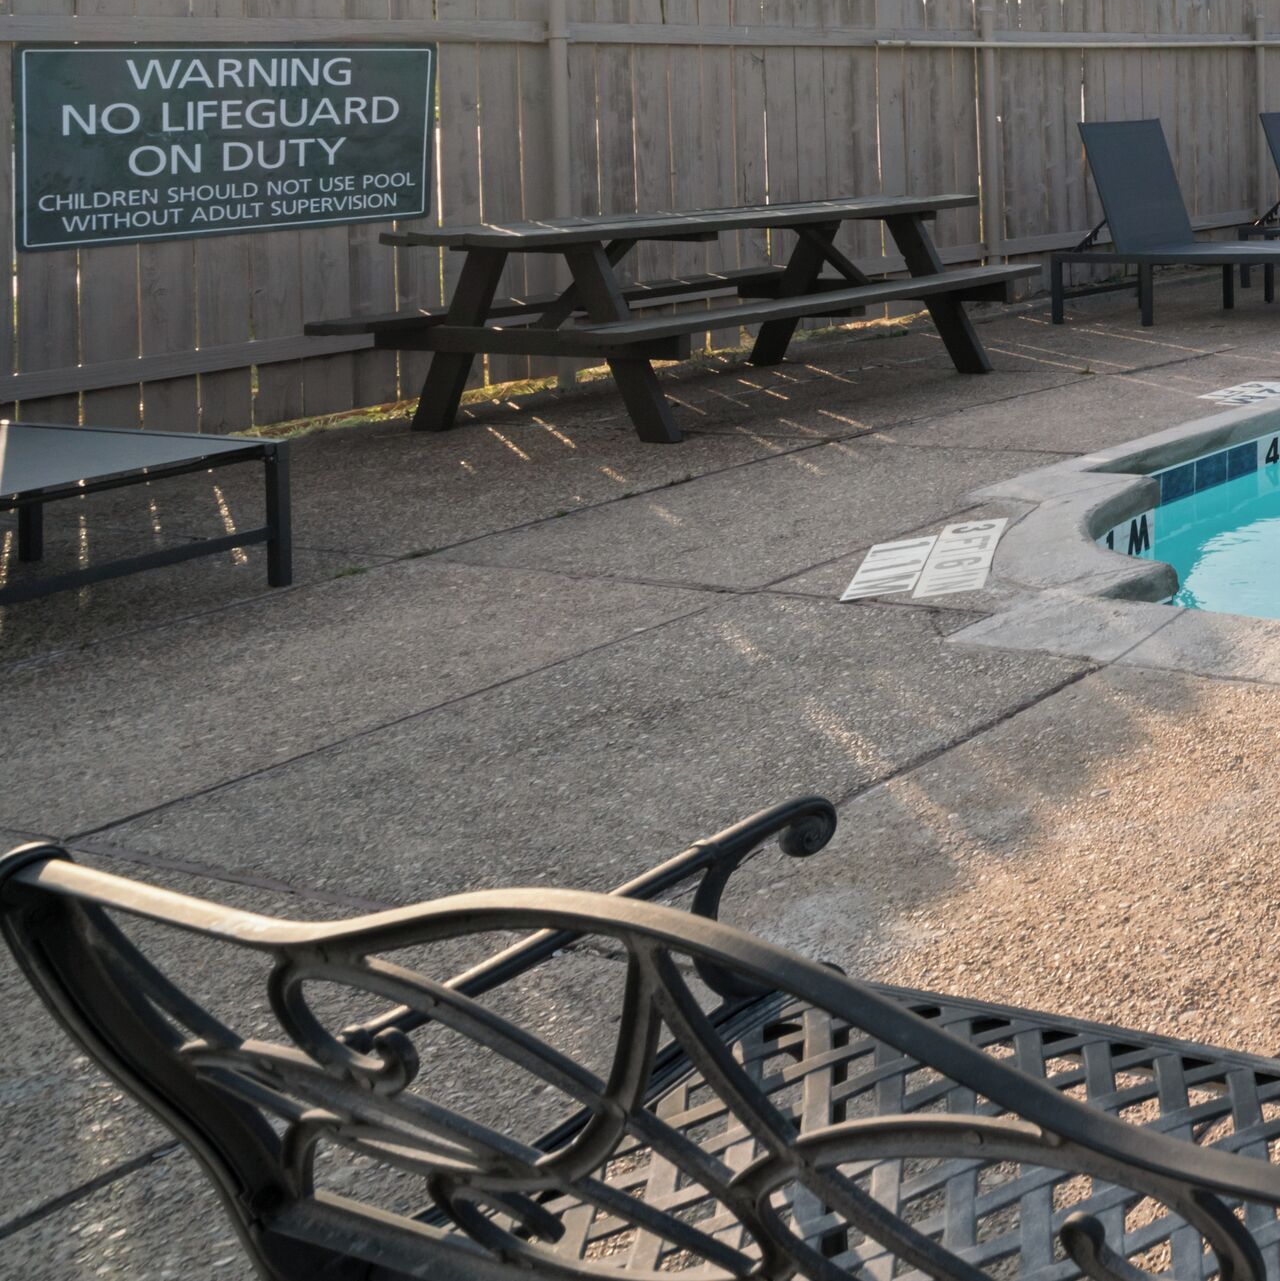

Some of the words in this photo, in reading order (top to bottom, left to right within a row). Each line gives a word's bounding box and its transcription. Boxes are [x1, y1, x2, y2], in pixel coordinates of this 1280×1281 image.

[127, 57, 352, 90] WARNING
[62, 103, 141, 136] NO
[162, 96, 400, 132] LIFEGUARD
[128, 144, 201, 177] ON
[222, 136, 346, 172] DUTY
[38, 188, 159, 212] CHILDREN
[167, 182, 258, 204] SHOULD
[267, 178, 312, 195] NOT
[319, 175, 355, 192] USE
[363, 172, 416, 189] POOL
[61, 208, 184, 232] WITHOUT
[190, 202, 265, 223] ADULT
[270, 192, 398, 217] SUPERVISION
[1265, 437, 1280, 464] 4
